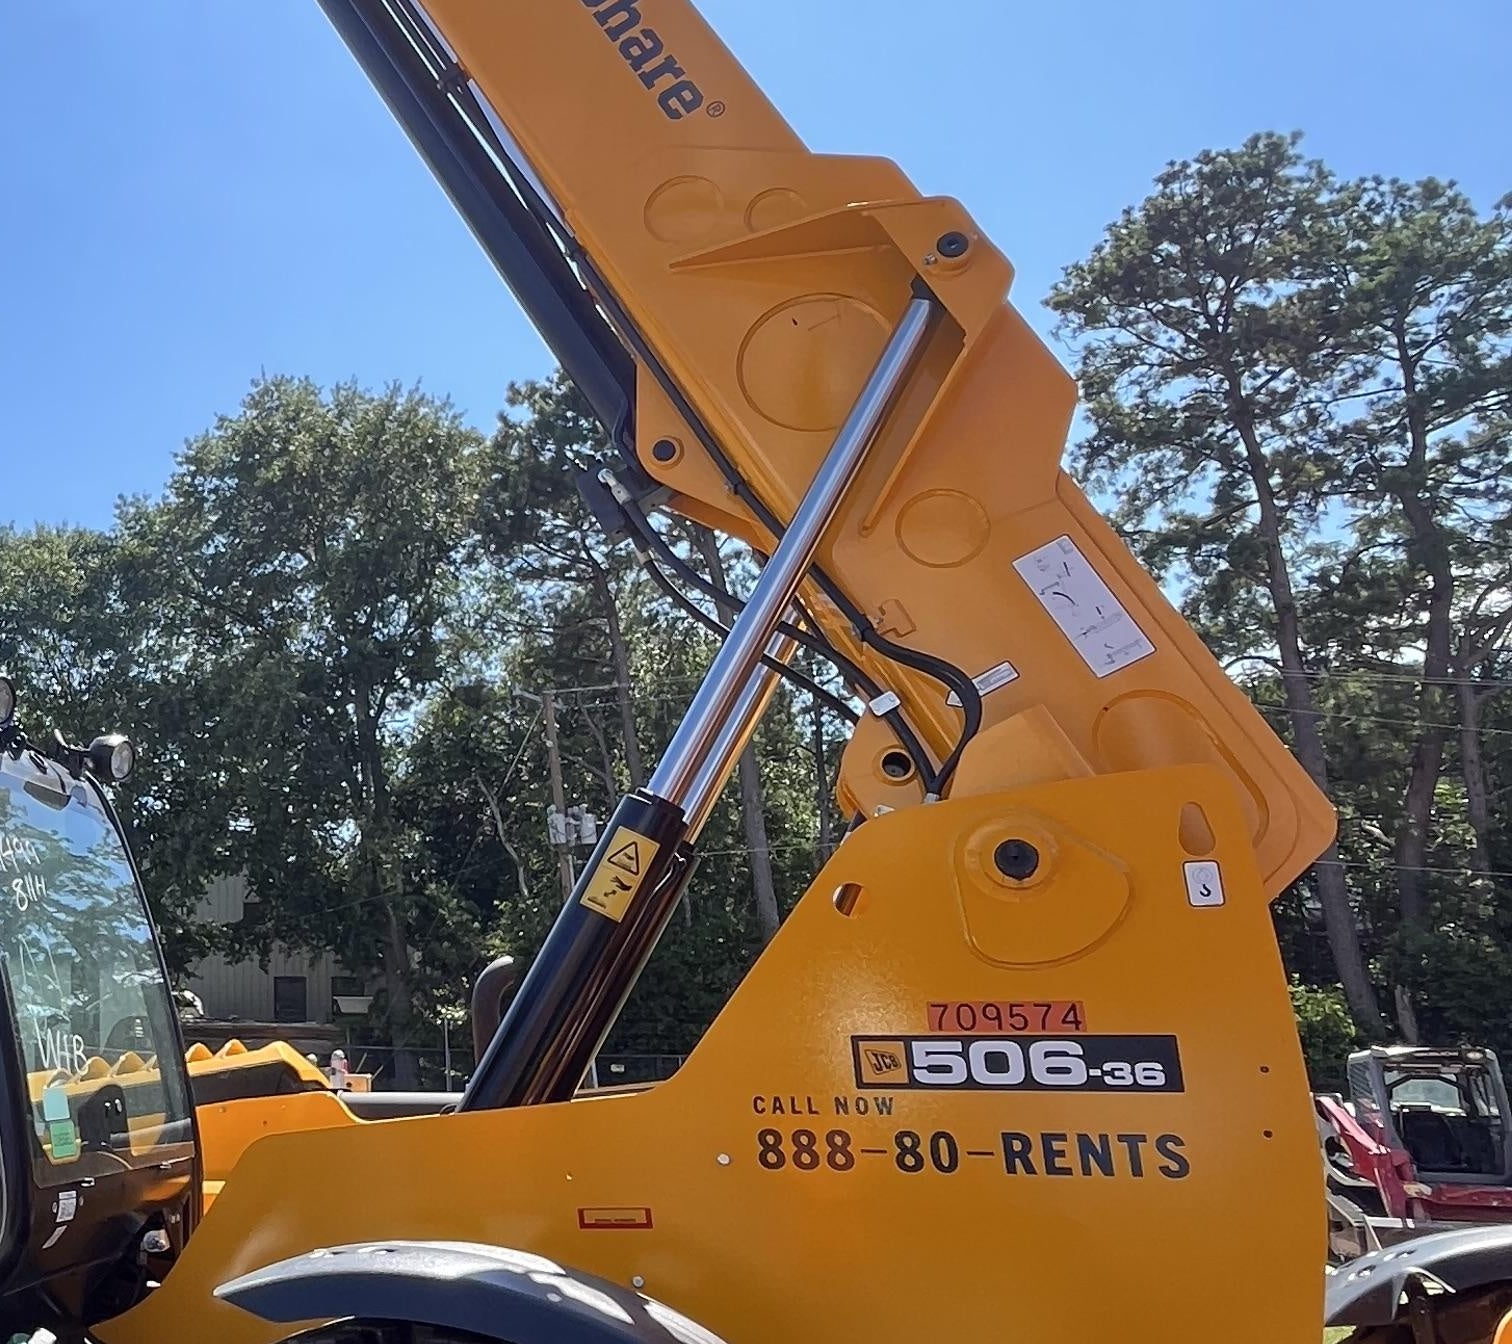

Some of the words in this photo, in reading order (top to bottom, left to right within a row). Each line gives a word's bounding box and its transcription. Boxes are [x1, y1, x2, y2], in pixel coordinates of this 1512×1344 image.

[930, 1002, 1083, 1032] 709574
[871, 1051, 898, 1071] JCB
[911, 1040, 1167, 1087] 506-36
[753, 1095, 819, 1116] CALL
[835, 1097, 895, 1116] NOW
